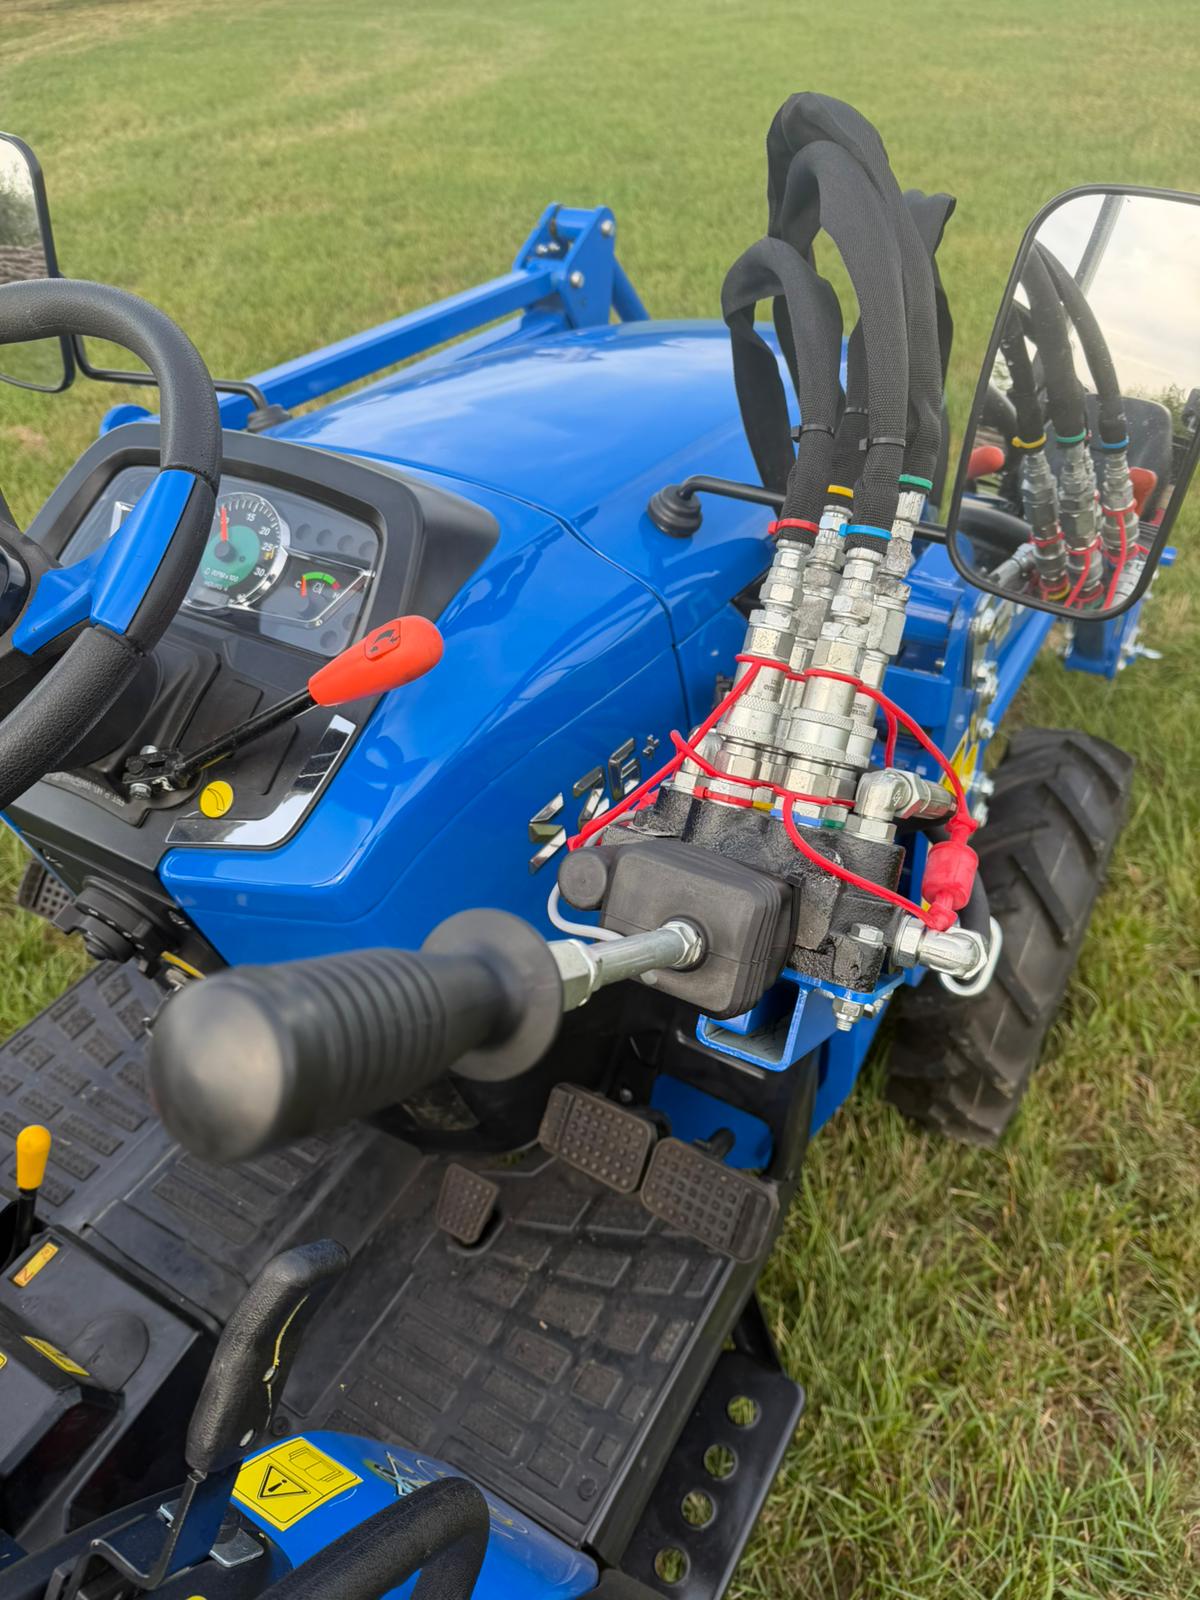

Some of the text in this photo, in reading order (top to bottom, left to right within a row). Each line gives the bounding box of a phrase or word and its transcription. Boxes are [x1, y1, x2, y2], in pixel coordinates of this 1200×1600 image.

[246, 513, 256, 522] 15
[259, 526, 271, 536] 20
[261, 543, 272, 551] 25
[253, 567, 265, 577] 30
